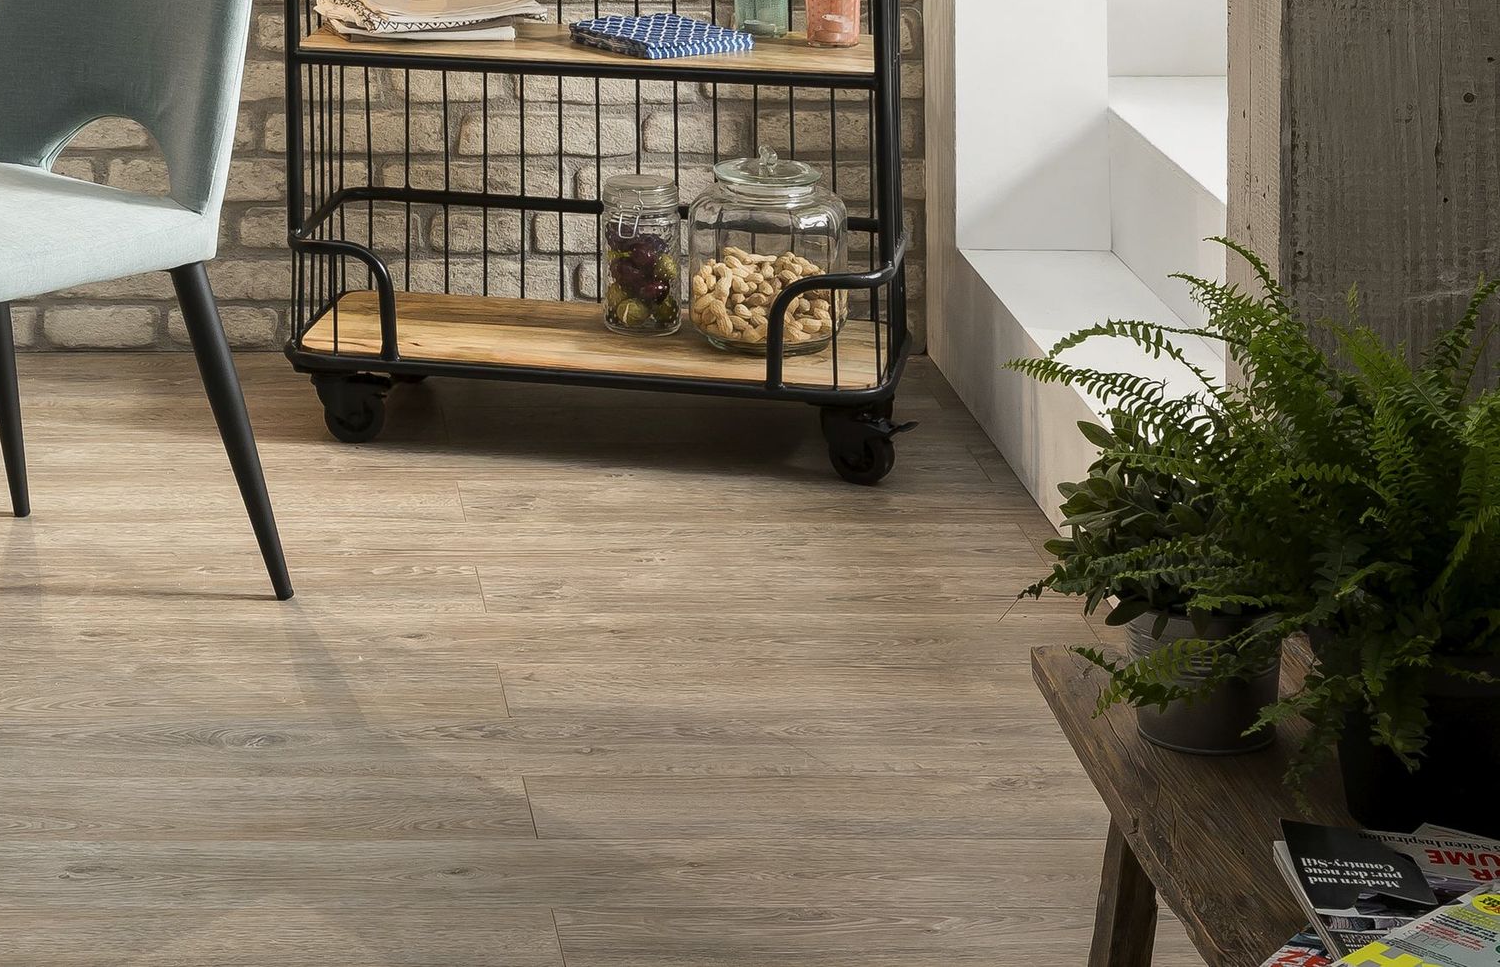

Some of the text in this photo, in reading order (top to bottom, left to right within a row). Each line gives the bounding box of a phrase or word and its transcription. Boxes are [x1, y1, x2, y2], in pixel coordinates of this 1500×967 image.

[1304, 866, 1341, 876] neue
[1343, 870, 1369, 880] der
[1307, 875, 1339, 885] und
